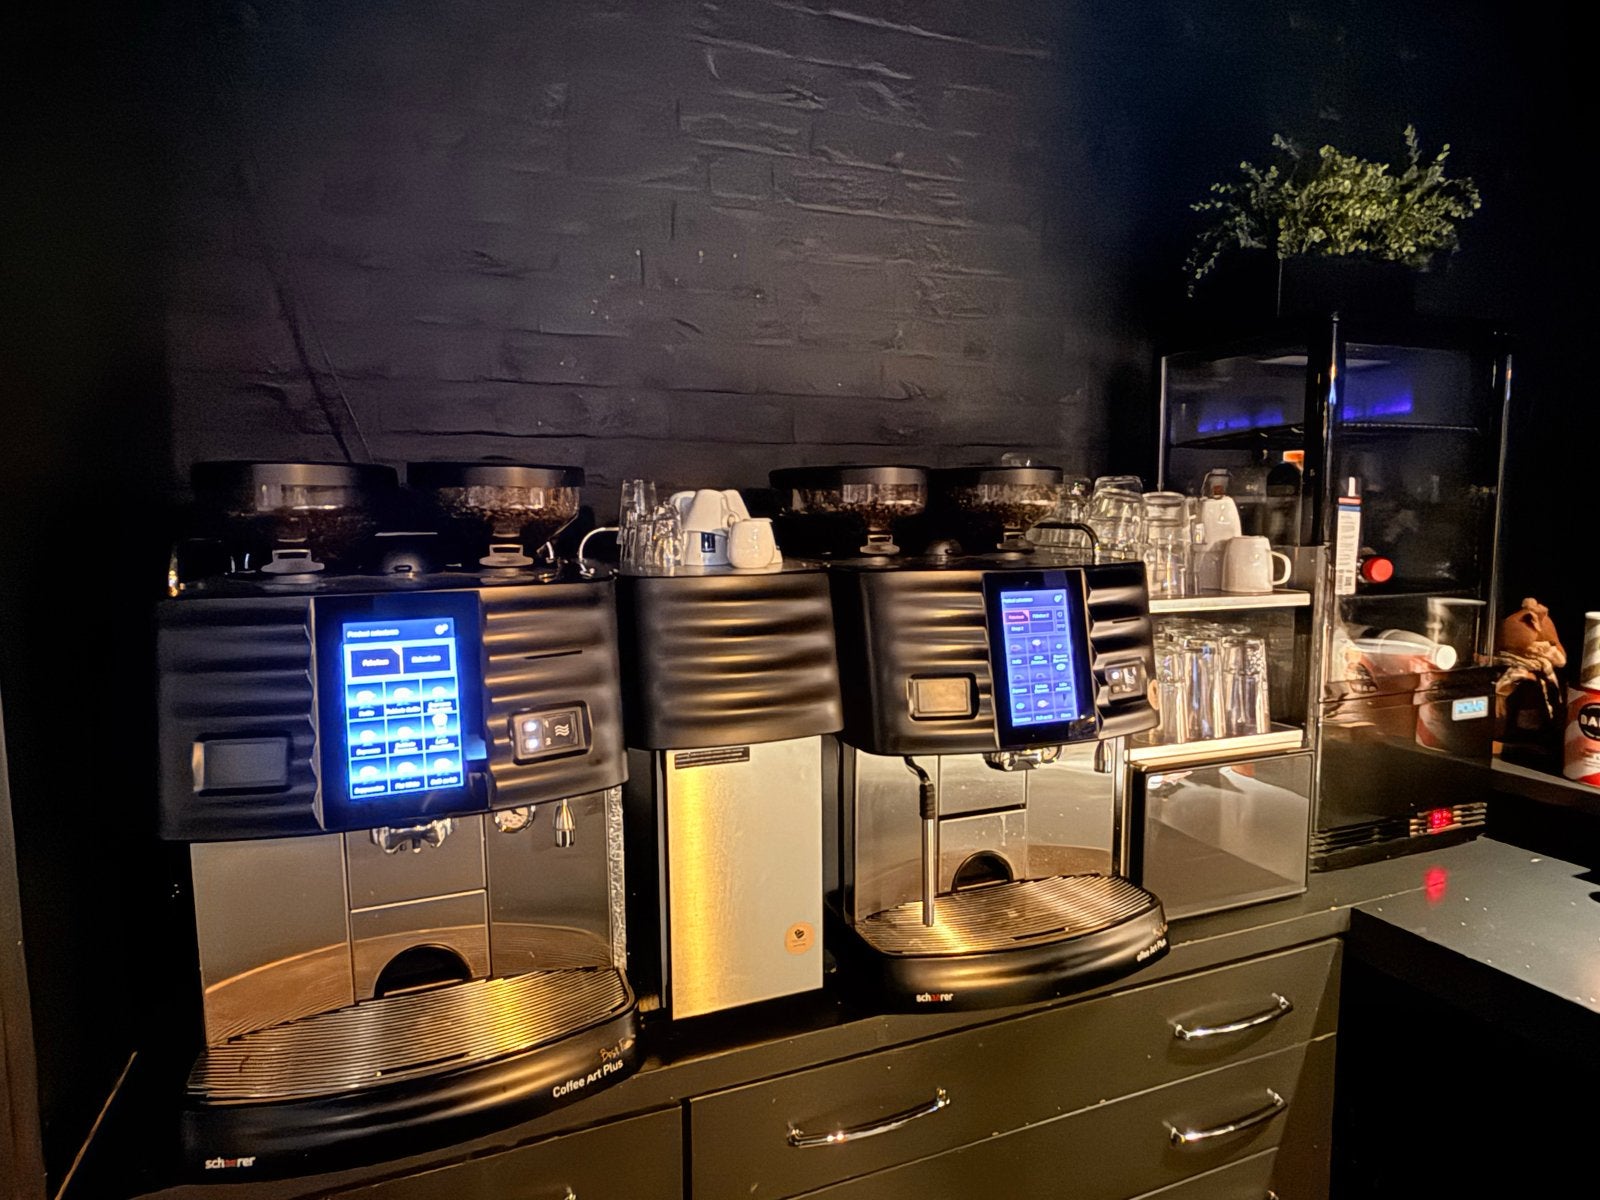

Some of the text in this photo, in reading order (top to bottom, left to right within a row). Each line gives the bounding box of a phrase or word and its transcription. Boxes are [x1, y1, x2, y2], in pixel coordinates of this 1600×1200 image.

[552, 1059, 624, 1098] Coffee Art Plus
